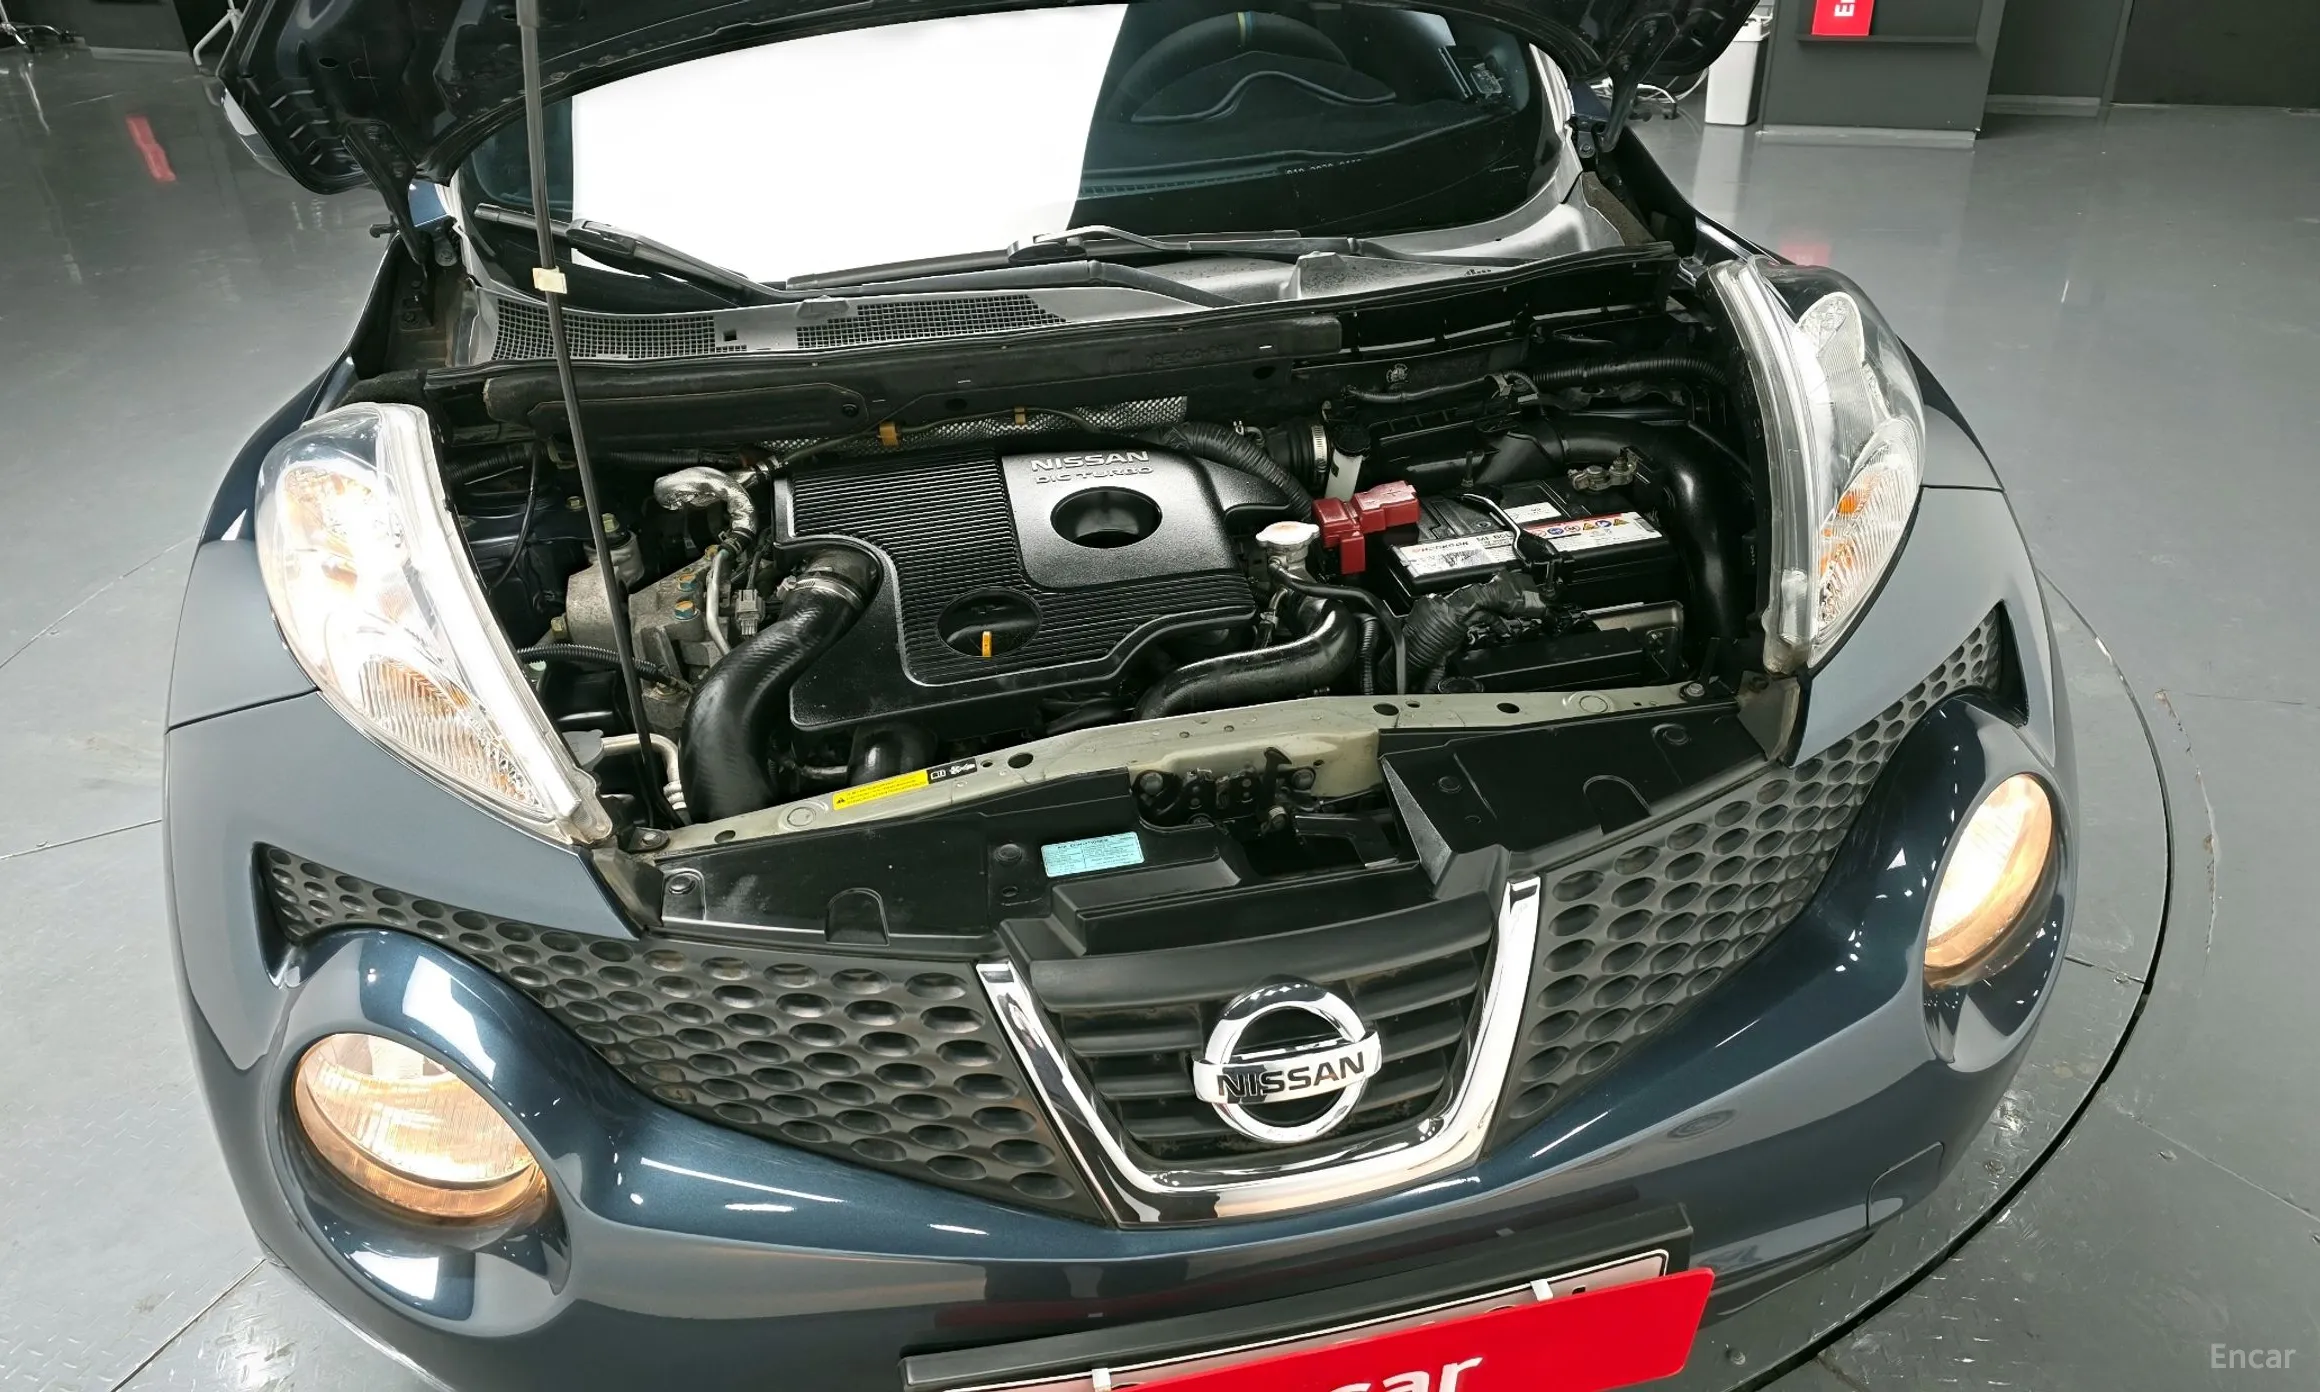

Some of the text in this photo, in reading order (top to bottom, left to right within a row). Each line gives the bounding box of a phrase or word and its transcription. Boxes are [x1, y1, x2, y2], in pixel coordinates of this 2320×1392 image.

[1833, 0, 1856, 17] E
[1030, 451, 1149, 471] NISSAN
[1077, 467, 1154, 478] TURBO
[1216, 1051, 1366, 1097] NISSAN
